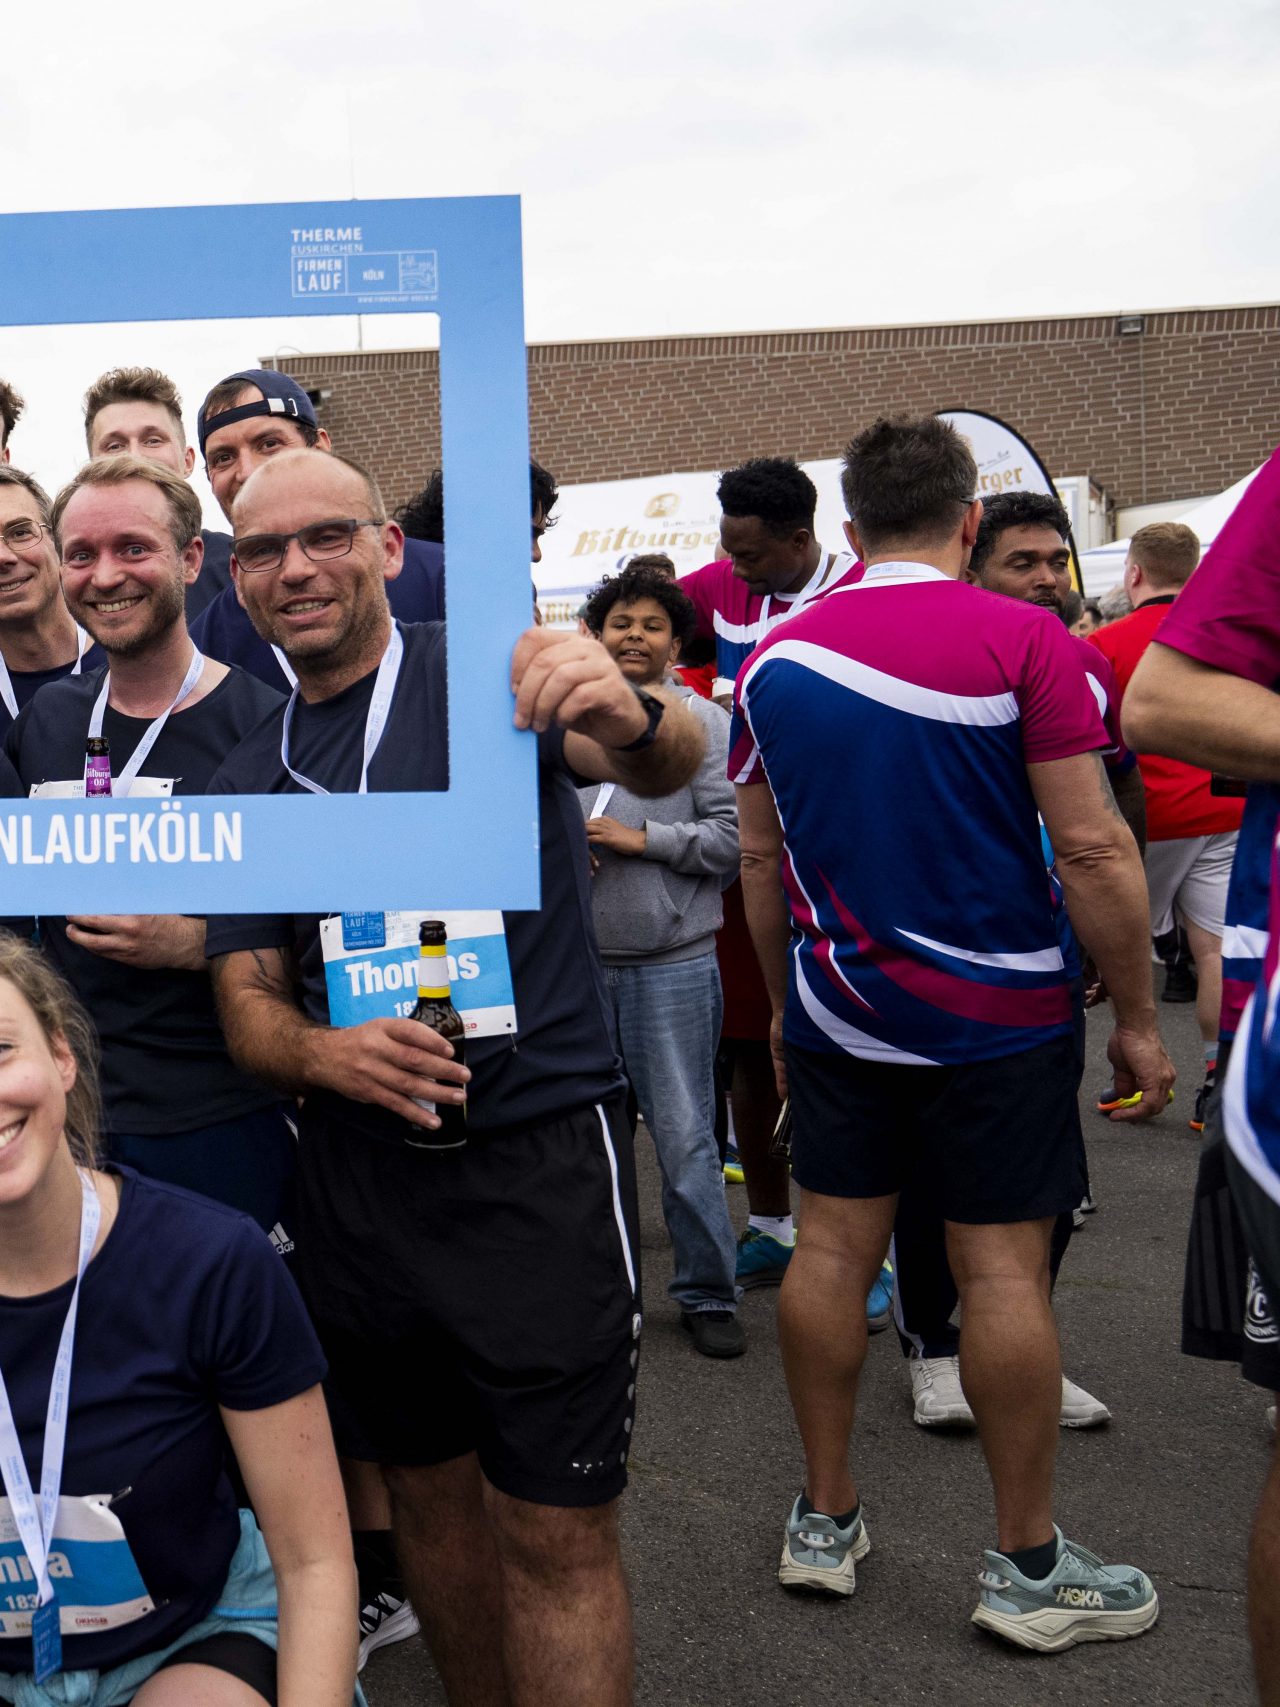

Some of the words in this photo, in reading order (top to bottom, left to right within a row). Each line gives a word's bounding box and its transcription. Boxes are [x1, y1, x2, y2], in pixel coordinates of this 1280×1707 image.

[291, 227, 363, 242] THERME
[291, 243, 363, 256] EUSKIRCHEN
[297, 258, 342, 272] FIRMEN
[297, 272, 342, 292] LAUF
[362, 269, 385, 281] KÖLN
[570, 525, 721, 557] Bitburge
[345, 917, 367, 929] LAUF
[1055, 1586, 1104, 1609] HOKA
